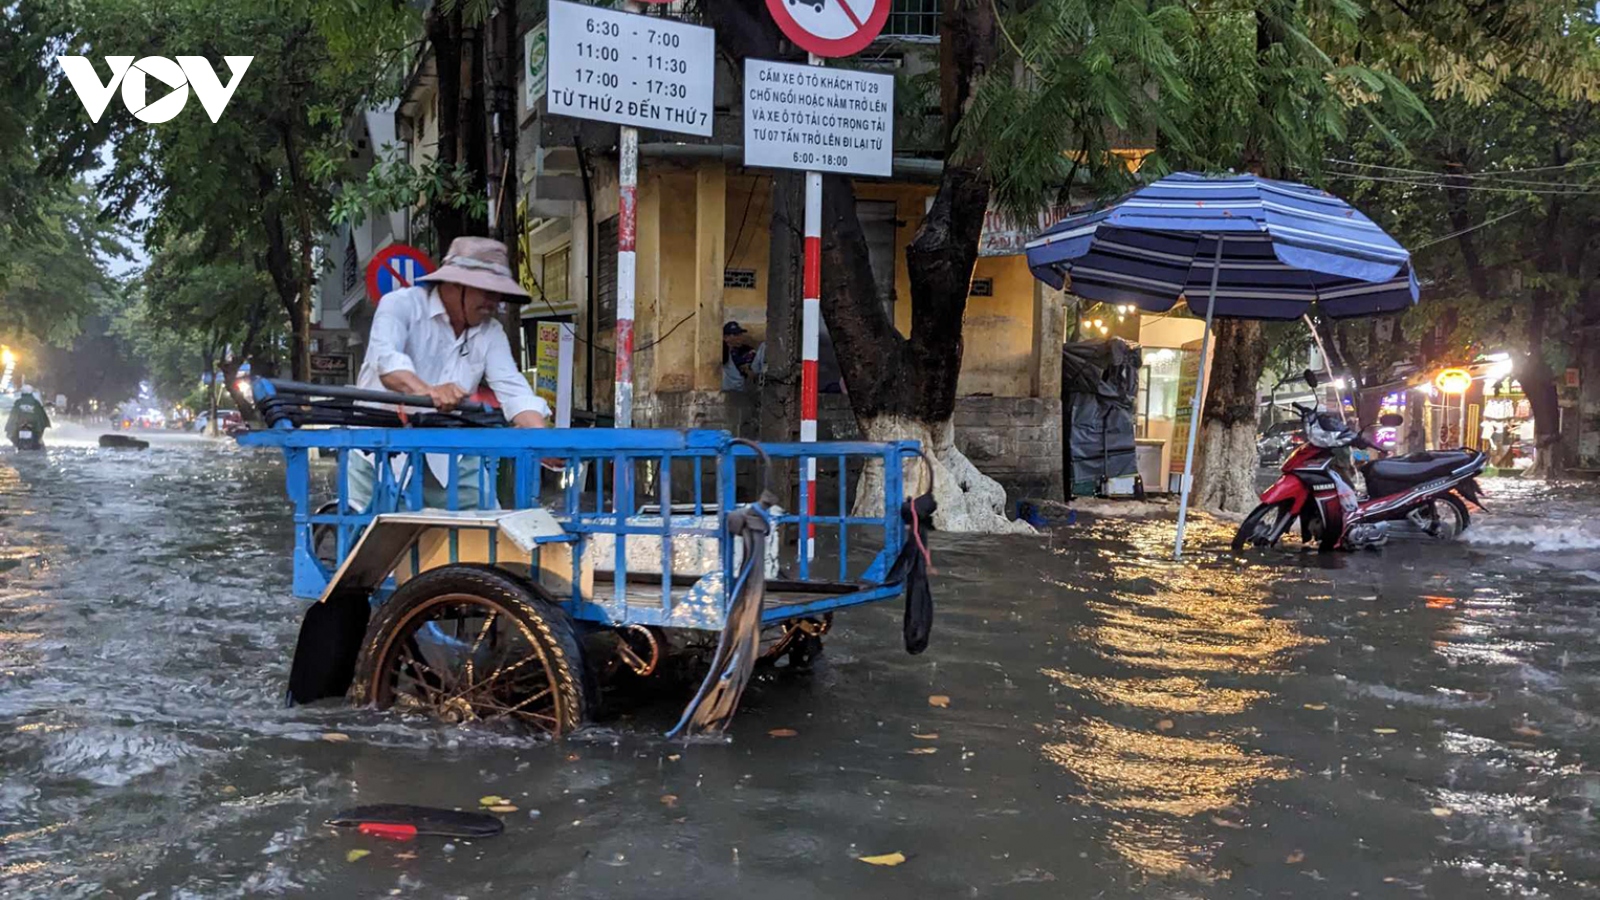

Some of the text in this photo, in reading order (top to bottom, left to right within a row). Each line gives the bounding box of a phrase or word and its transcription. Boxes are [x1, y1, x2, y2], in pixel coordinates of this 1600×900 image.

[586, 18, 619, 37] 6:30
[648, 30, 680, 48] 7:00
[577, 42, 619, 62] 11:00
[647, 55, 687, 74] 11:30
[576, 68, 618, 88] 17:00
[647, 80, 687, 99] 17:30
[759, 67, 879, 94] CẤM XE Ô TÔ KHÁCH TỪ 29
[552, 88, 708, 126] TỪ THỨ 2 ĐẾN THỨ 7
[750, 87, 771, 101] CHỖ
[798, 94, 824, 109] HOẶC
[849, 96, 868, 111] TRỞ
[869, 99, 887, 113] LÊN
[752, 106, 885, 132] VÀ XE Ô TÔ TẢI CÓ TRỌNG TẢI
[768, 130, 778, 141] 07
[781, 127, 799, 143] TẤN
[802, 130, 821, 145] TRỞ
[823, 133, 841, 147] LÊN
[843, 136, 852, 147] ĐI
[854, 138, 869, 151] LẠI
[870, 137, 883, 150] TỪ
[793, 152, 814, 164] 6:00
[822, 154, 848, 167] 18:00
